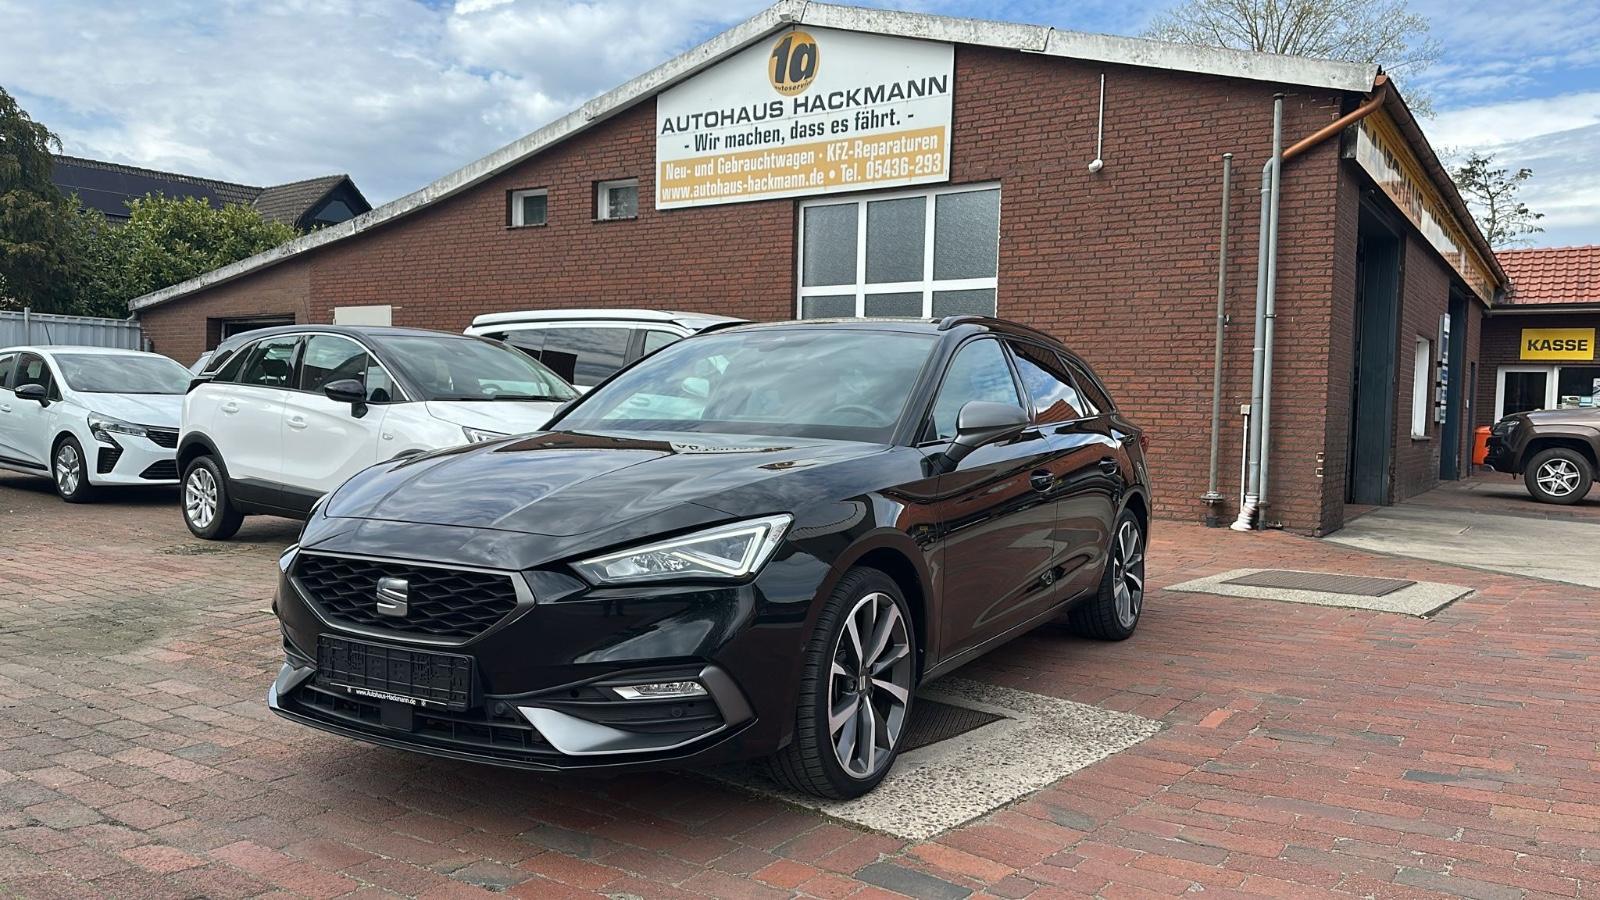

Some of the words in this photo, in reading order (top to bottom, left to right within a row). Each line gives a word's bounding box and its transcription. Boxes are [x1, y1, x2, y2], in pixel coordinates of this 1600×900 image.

[771, 37, 817, 83] 1a
[661, 101, 784, 134] AUTOHAUS
[794, 75, 948, 115] HACKMANN
[695, 133, 720, 151] Wir
[725, 127, 786, 148] machen,
[790, 122, 825, 140] dass
[831, 118, 849, 133] es
[854, 109, 900, 131] fährt.
[661, 169, 825, 201] www.autohaus-hackmann.de
[840, 164, 862, 183] Tel.
[866, 153, 941, 180] 05436-293
[665, 162, 691, 181] Neu-
[694, 158, 714, 177] und
[717, 153, 815, 174] Gebrauchtwagen
[826, 134, 938, 162] KFZ-Reparaturen
[1527, 339, 1588, 352] KASSE
